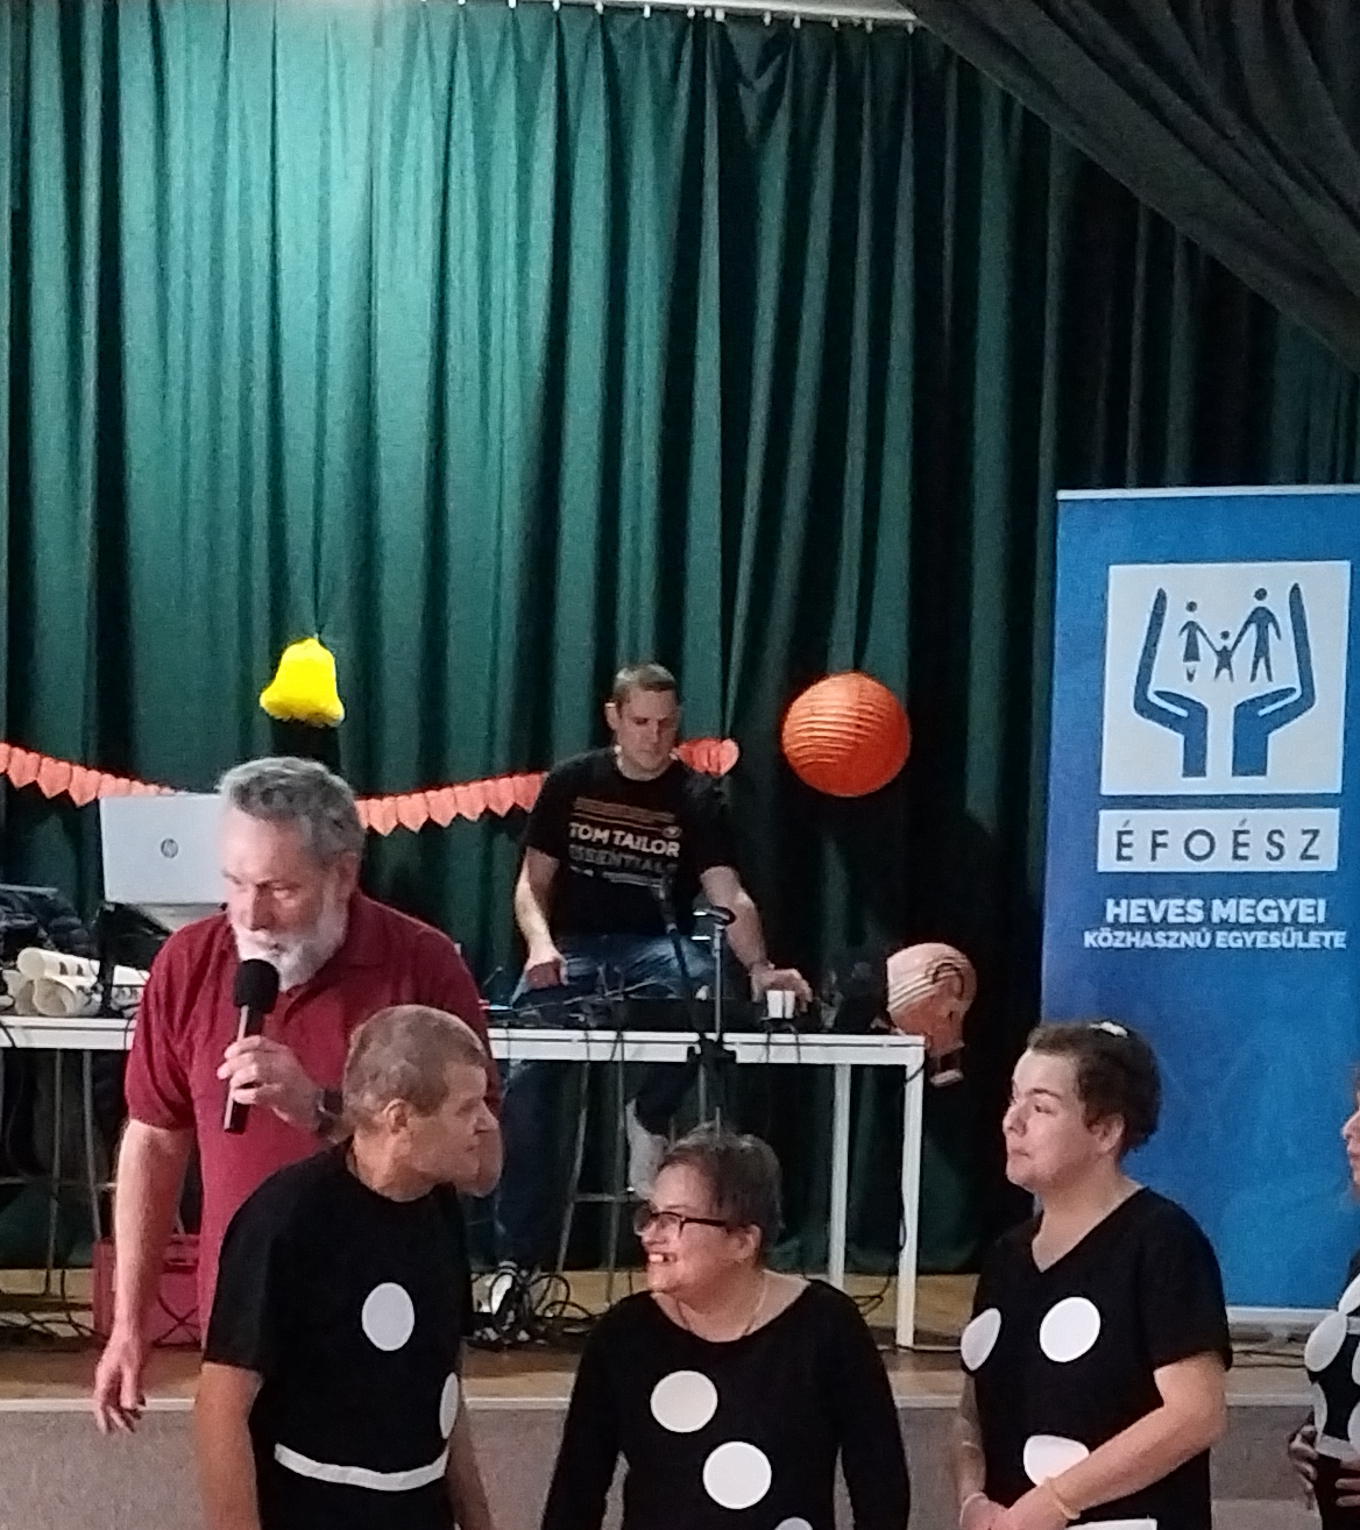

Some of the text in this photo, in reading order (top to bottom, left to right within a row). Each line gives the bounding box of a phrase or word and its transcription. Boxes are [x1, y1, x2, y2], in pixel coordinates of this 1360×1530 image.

[568, 822, 681, 858] TOM TAILOR
[1115, 818, 1321, 862] ÉFOÉSZ
[1105, 898, 1326, 924] HEVES MEGYEI
[1084, 926, 1347, 949] KÖZHASZNÚ EGYESÜLETE
